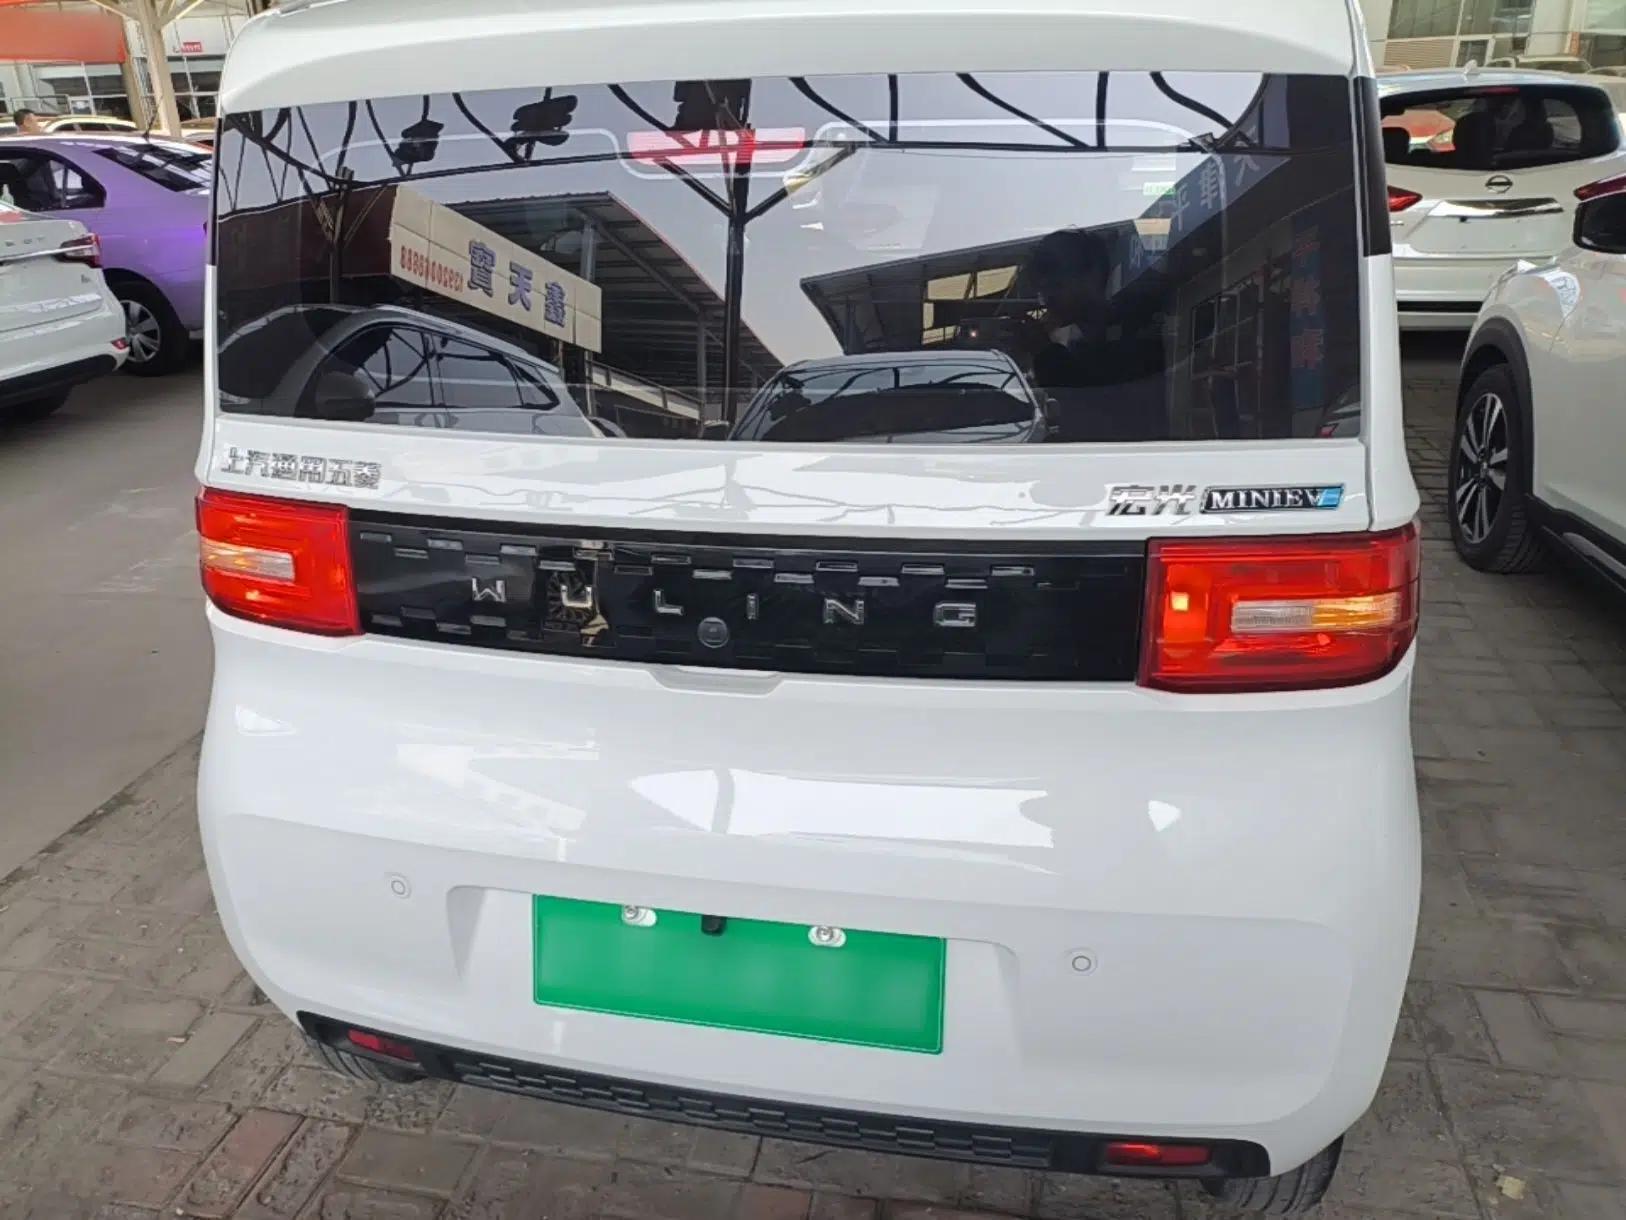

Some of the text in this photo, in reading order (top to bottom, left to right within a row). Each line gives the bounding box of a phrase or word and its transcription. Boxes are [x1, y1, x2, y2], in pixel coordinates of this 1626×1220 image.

[221, 447, 381, 489] 上汽通用五菱
[1105, 485, 1196, 515] 宏光
[1211, 488, 1325, 509] MINIEV
